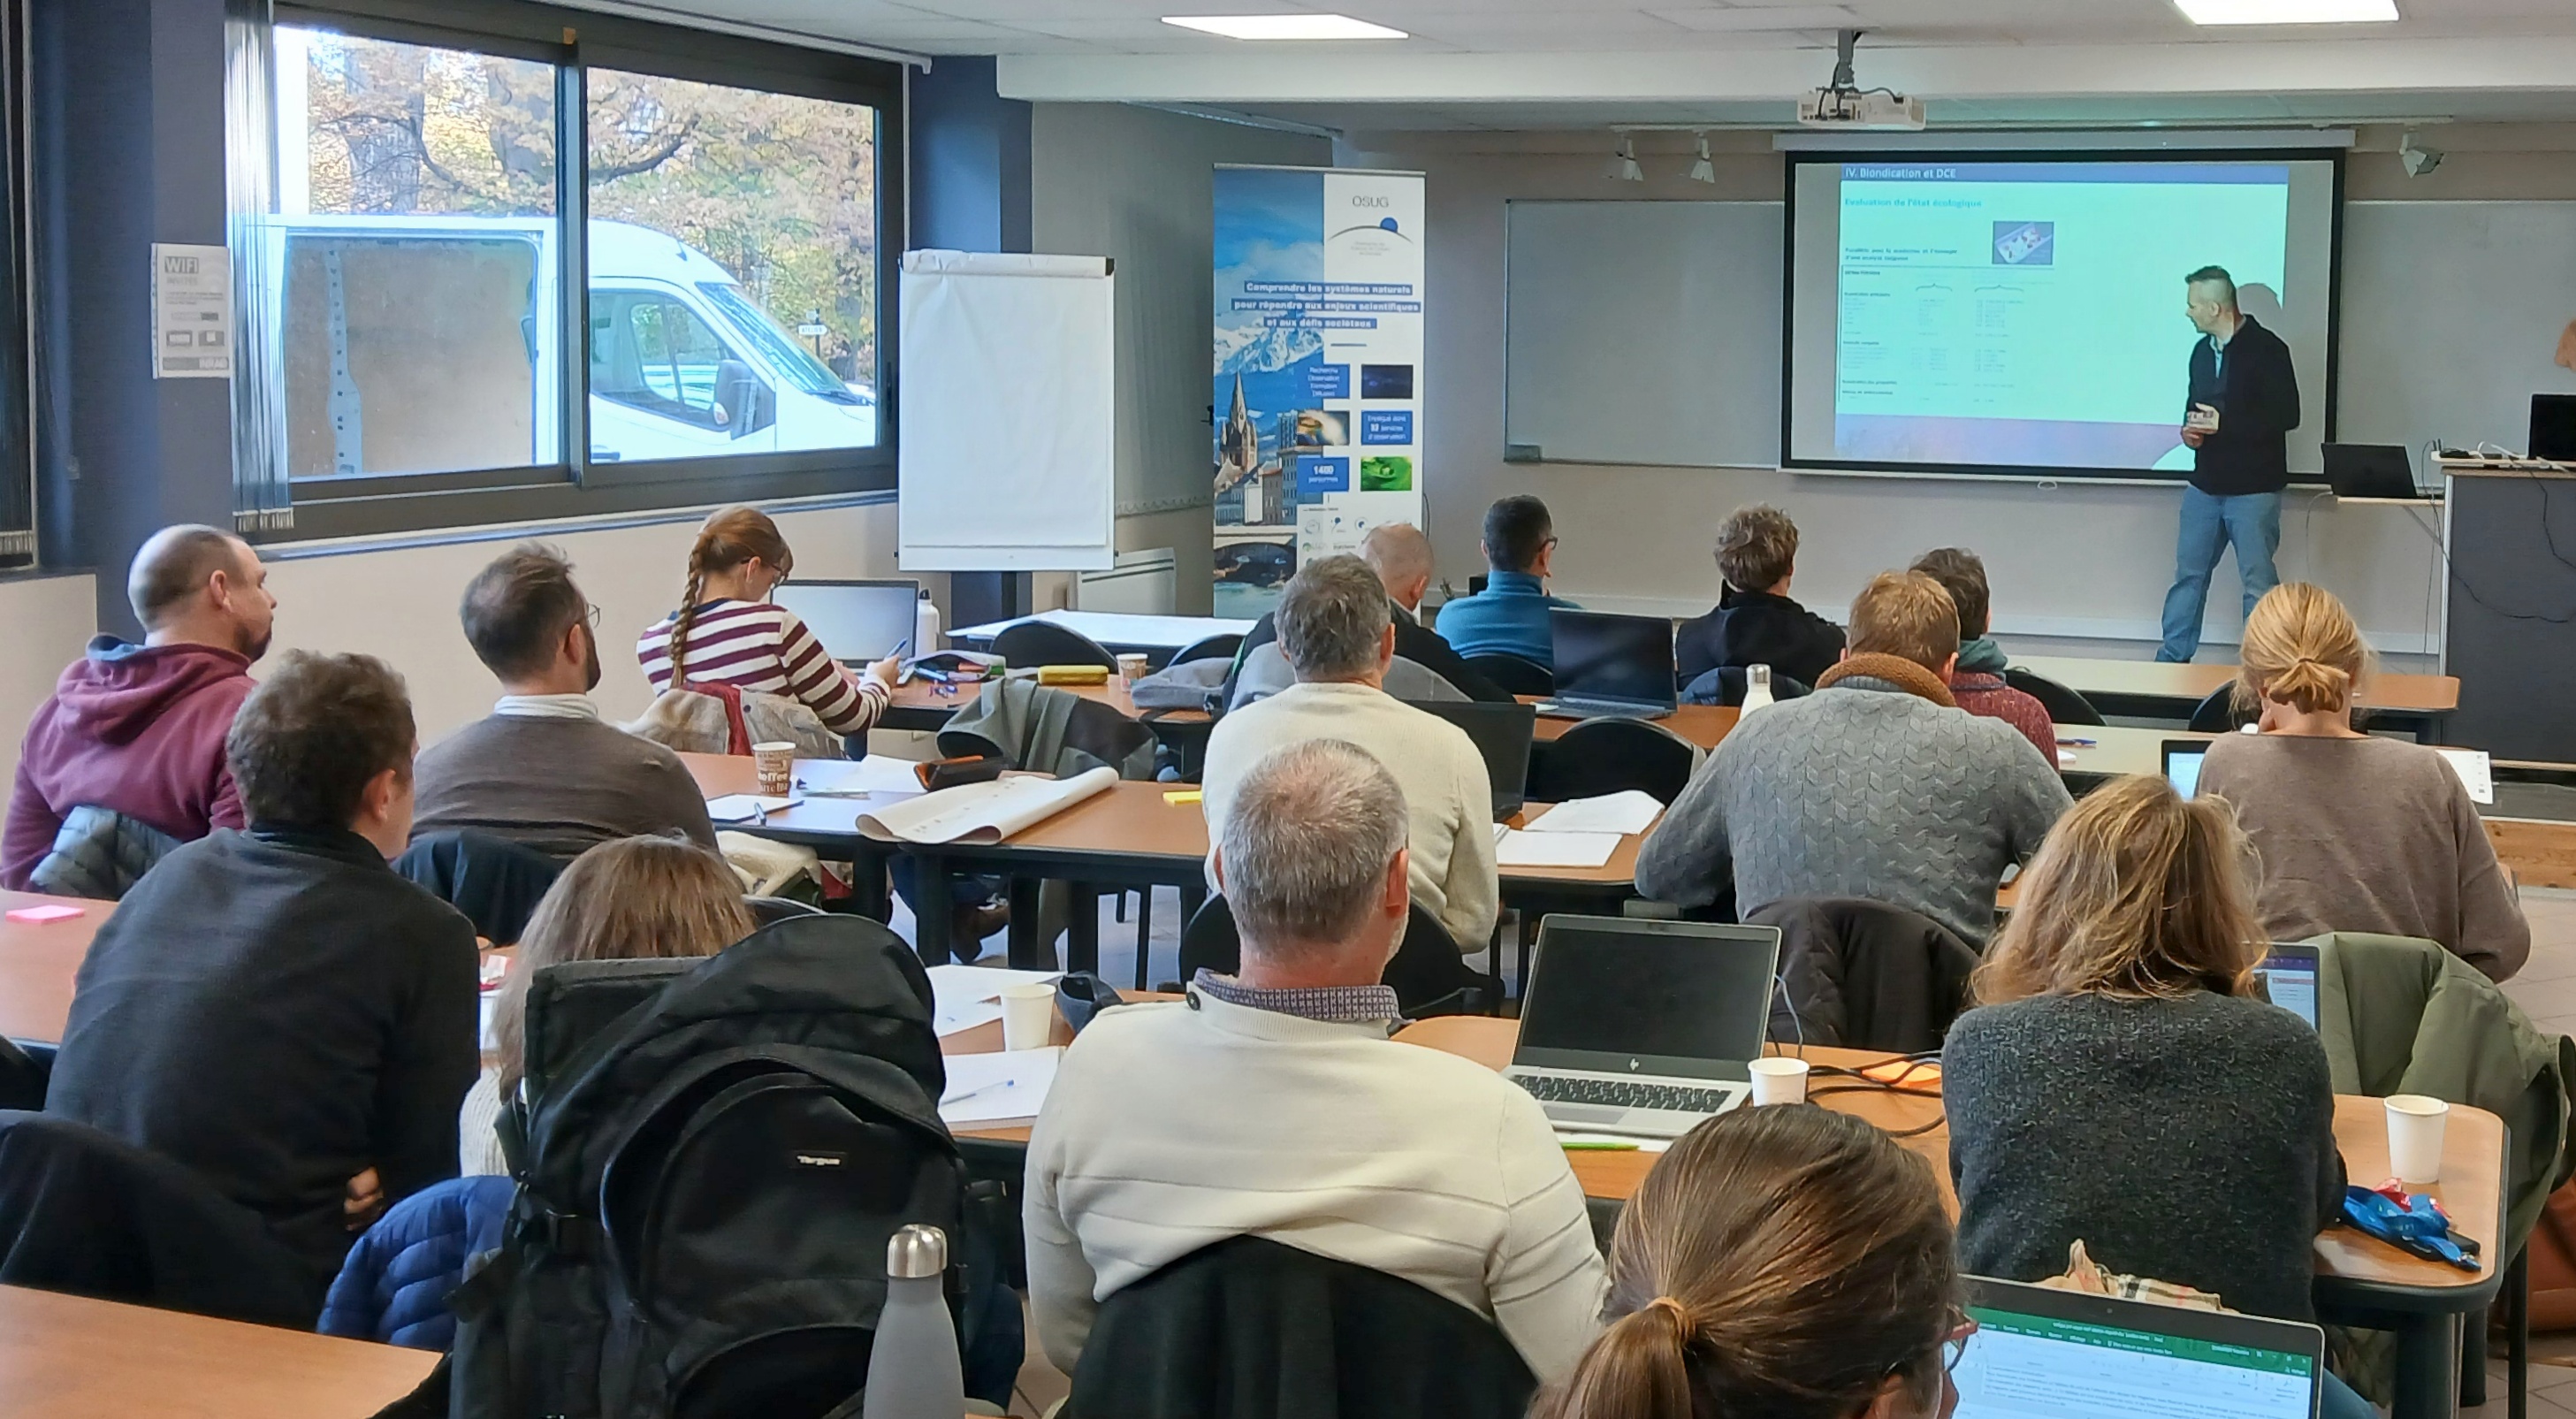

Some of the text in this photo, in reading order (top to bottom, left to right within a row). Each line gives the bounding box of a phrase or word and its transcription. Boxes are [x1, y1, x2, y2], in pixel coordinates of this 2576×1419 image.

[1923, 169, 1934, 179] et
[1936, 168, 1956, 179] DCE
[1352, 195, 1389, 208] OSUG
[1894, 198, 1906, 207] de
[165, 256, 199, 273] WIFI
[1246, 282, 1411, 294] Comprendre les systèmes naturels
[1234, 301, 1257, 310] pour
[1259, 300, 1303, 310] répondre
[1324, 301, 1357, 311] enjeux
[1359, 301, 1419, 312] scientifiques
[1299, 317, 1322, 327] défis
[1325, 318, 1371, 328] sociétaux
